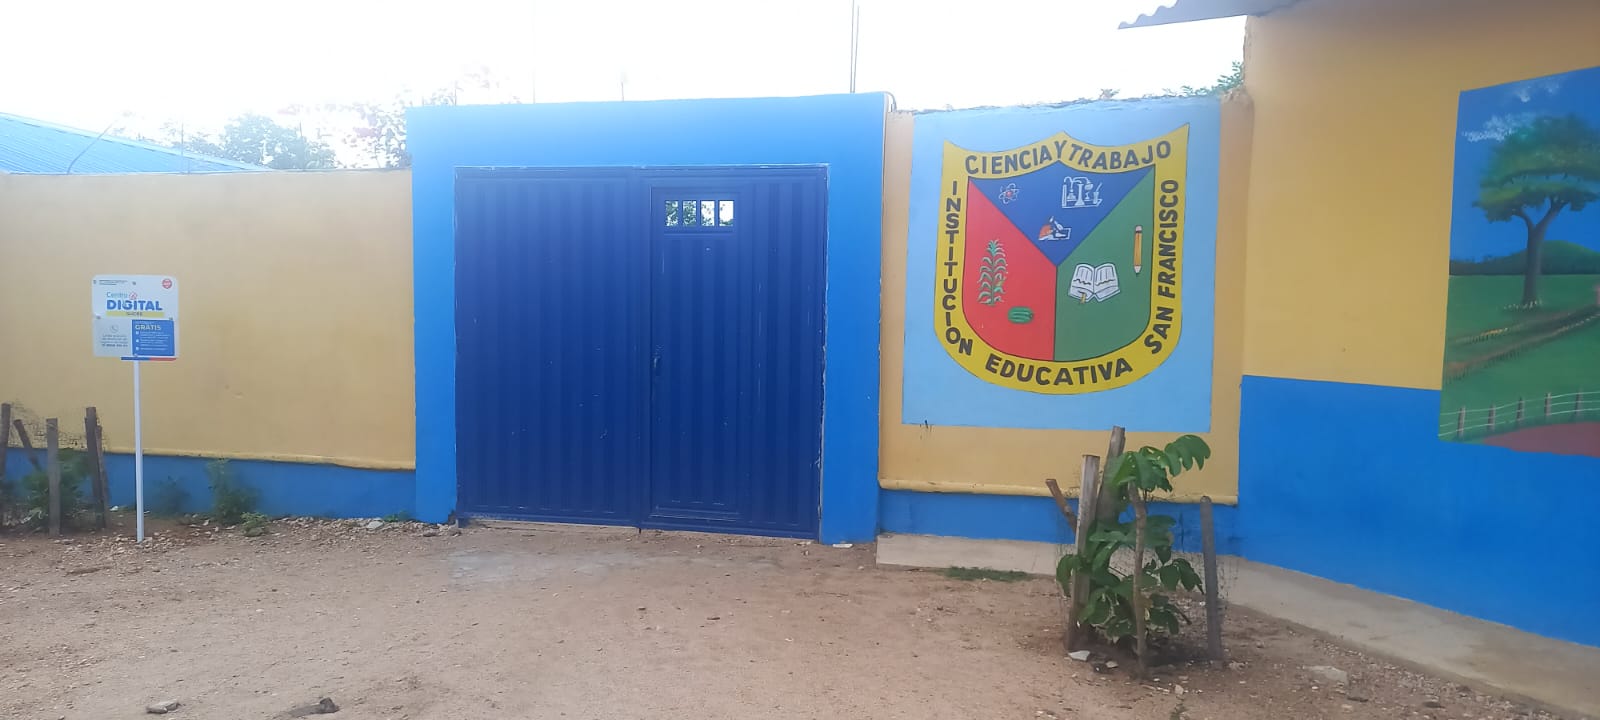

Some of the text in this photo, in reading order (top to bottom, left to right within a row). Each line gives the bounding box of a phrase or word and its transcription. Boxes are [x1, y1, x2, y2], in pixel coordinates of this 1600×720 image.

[965, 140, 1171, 174] CIENCIA Y TRABAJO
[942, 179, 1179, 386] INSTITUCION EDUCATIVA SAN FRANCISCO
[107, 300, 163, 311] DIGITAL
